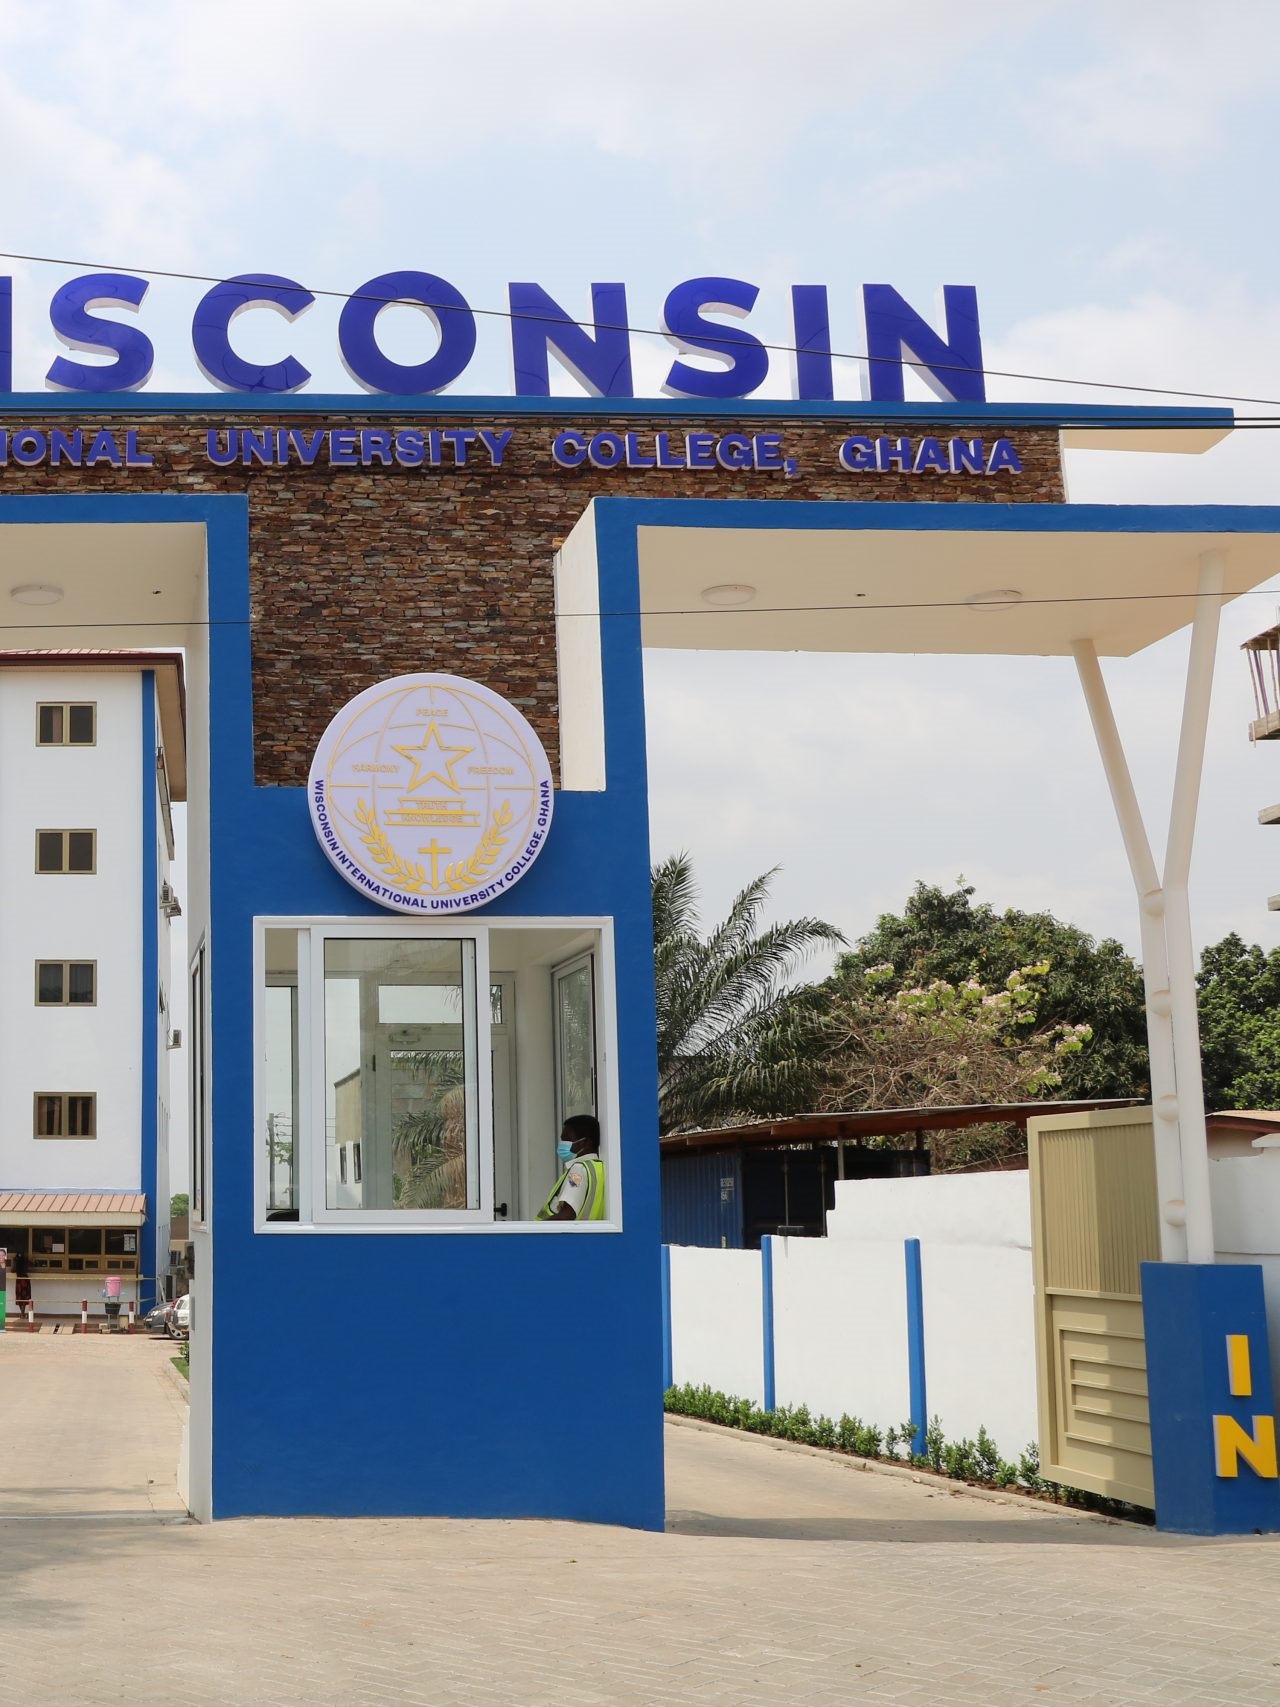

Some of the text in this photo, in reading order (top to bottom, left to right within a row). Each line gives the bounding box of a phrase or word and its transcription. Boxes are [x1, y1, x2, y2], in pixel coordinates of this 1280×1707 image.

[207, 428, 514, 468] UNIVERSITY
[552, 431, 797, 477] COLLEGE,
[838, 435, 1023, 476] GHANA
[314, 780, 550, 910] WISCONSIN INTERNATIONAL UNIVERSITY COLLEGE, GHANA
[1212, 1334, 1279, 1478] IN
